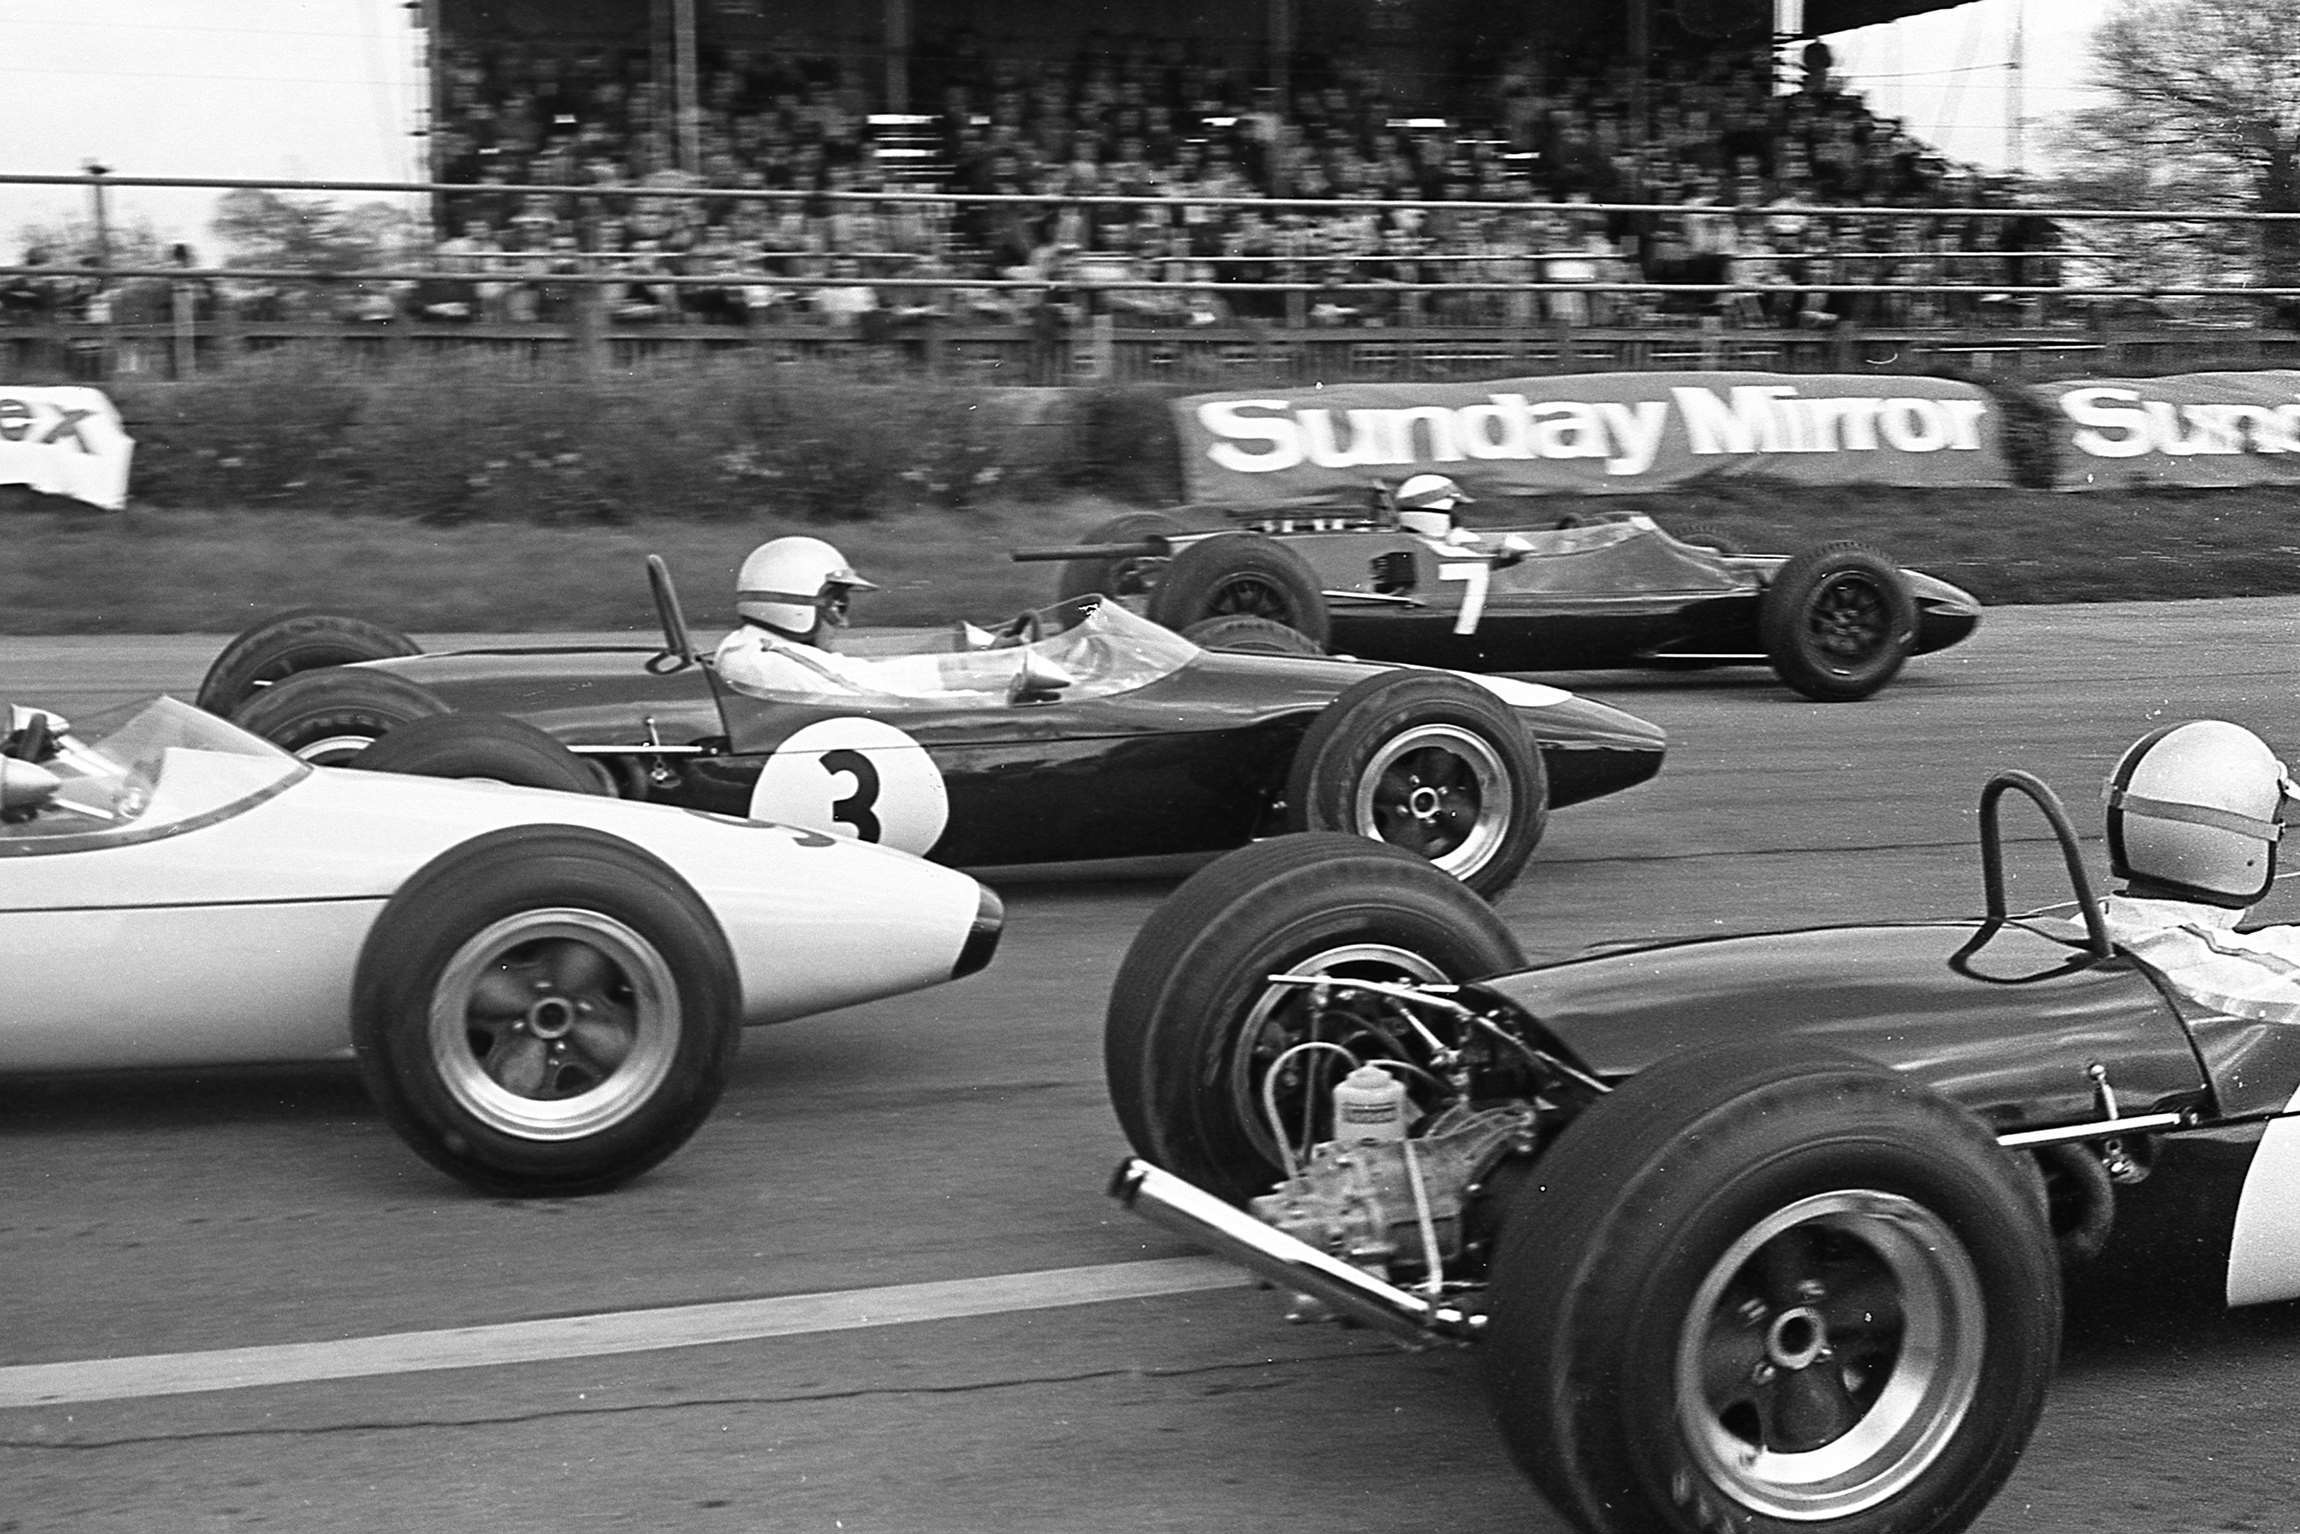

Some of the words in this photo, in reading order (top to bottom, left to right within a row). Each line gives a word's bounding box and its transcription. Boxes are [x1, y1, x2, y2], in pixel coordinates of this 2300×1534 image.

[0, 399, 98, 455] ex
[1200, 394, 1668, 475] Sunday
[1670, 385, 1987, 454] Mirror
[1438, 562, 1489, 635] 7
[819, 749, 881, 844] 3
